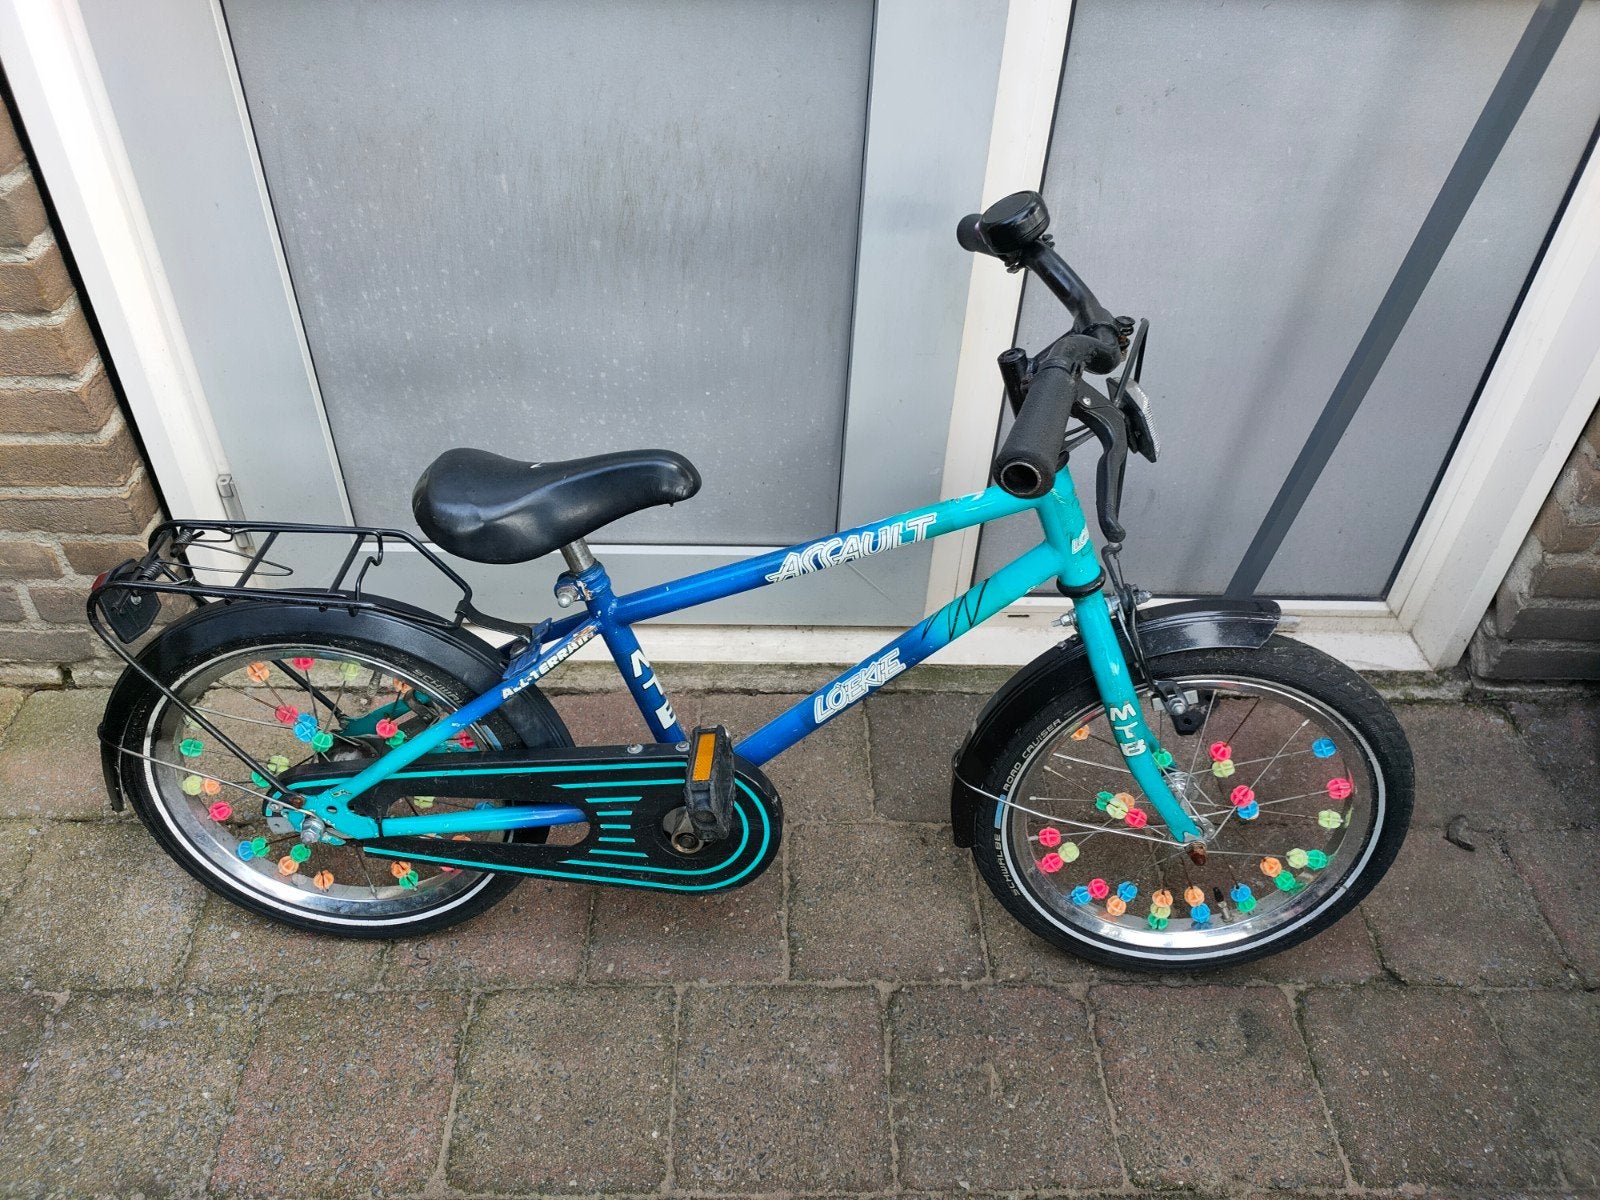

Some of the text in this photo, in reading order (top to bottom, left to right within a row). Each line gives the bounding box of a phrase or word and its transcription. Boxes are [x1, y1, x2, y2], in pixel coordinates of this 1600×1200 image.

[813, 647, 907, 723] LOEKIE
[1109, 703, 1147, 757] MTB
[994, 718, 1062, 896] SCHWALBE ROAD CRUISER
